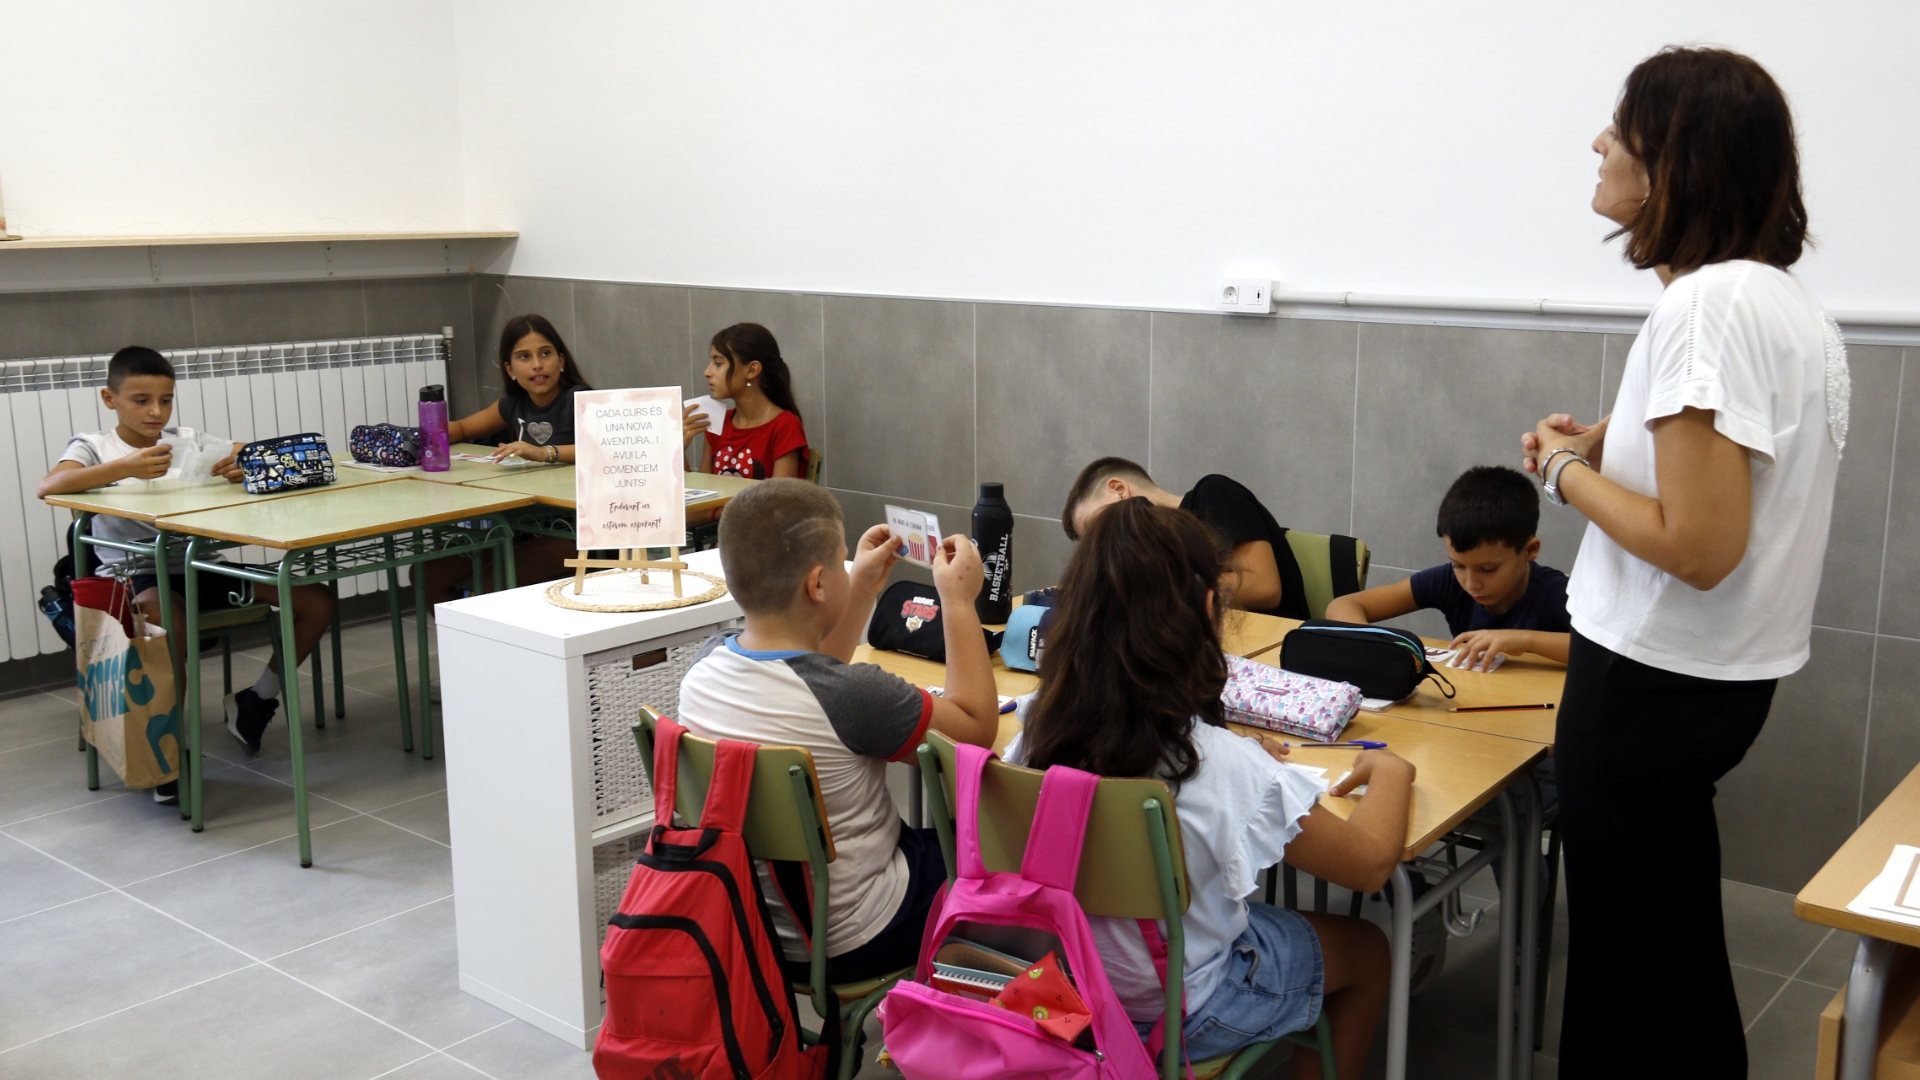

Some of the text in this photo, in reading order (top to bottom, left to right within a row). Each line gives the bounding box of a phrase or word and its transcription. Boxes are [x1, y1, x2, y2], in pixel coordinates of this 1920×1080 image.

[595, 405, 663, 419] CADA CURS ÉS
[605, 421, 653, 433] UNA NOVA
[612, 450, 647, 460] AVUI LA
[602, 464, 658, 475] COMENCEM
[615, 478, 647, 488] JUNTS!
[989, 534, 1009, 602] BASKETBALL
[901, 599, 940, 621] STARS
